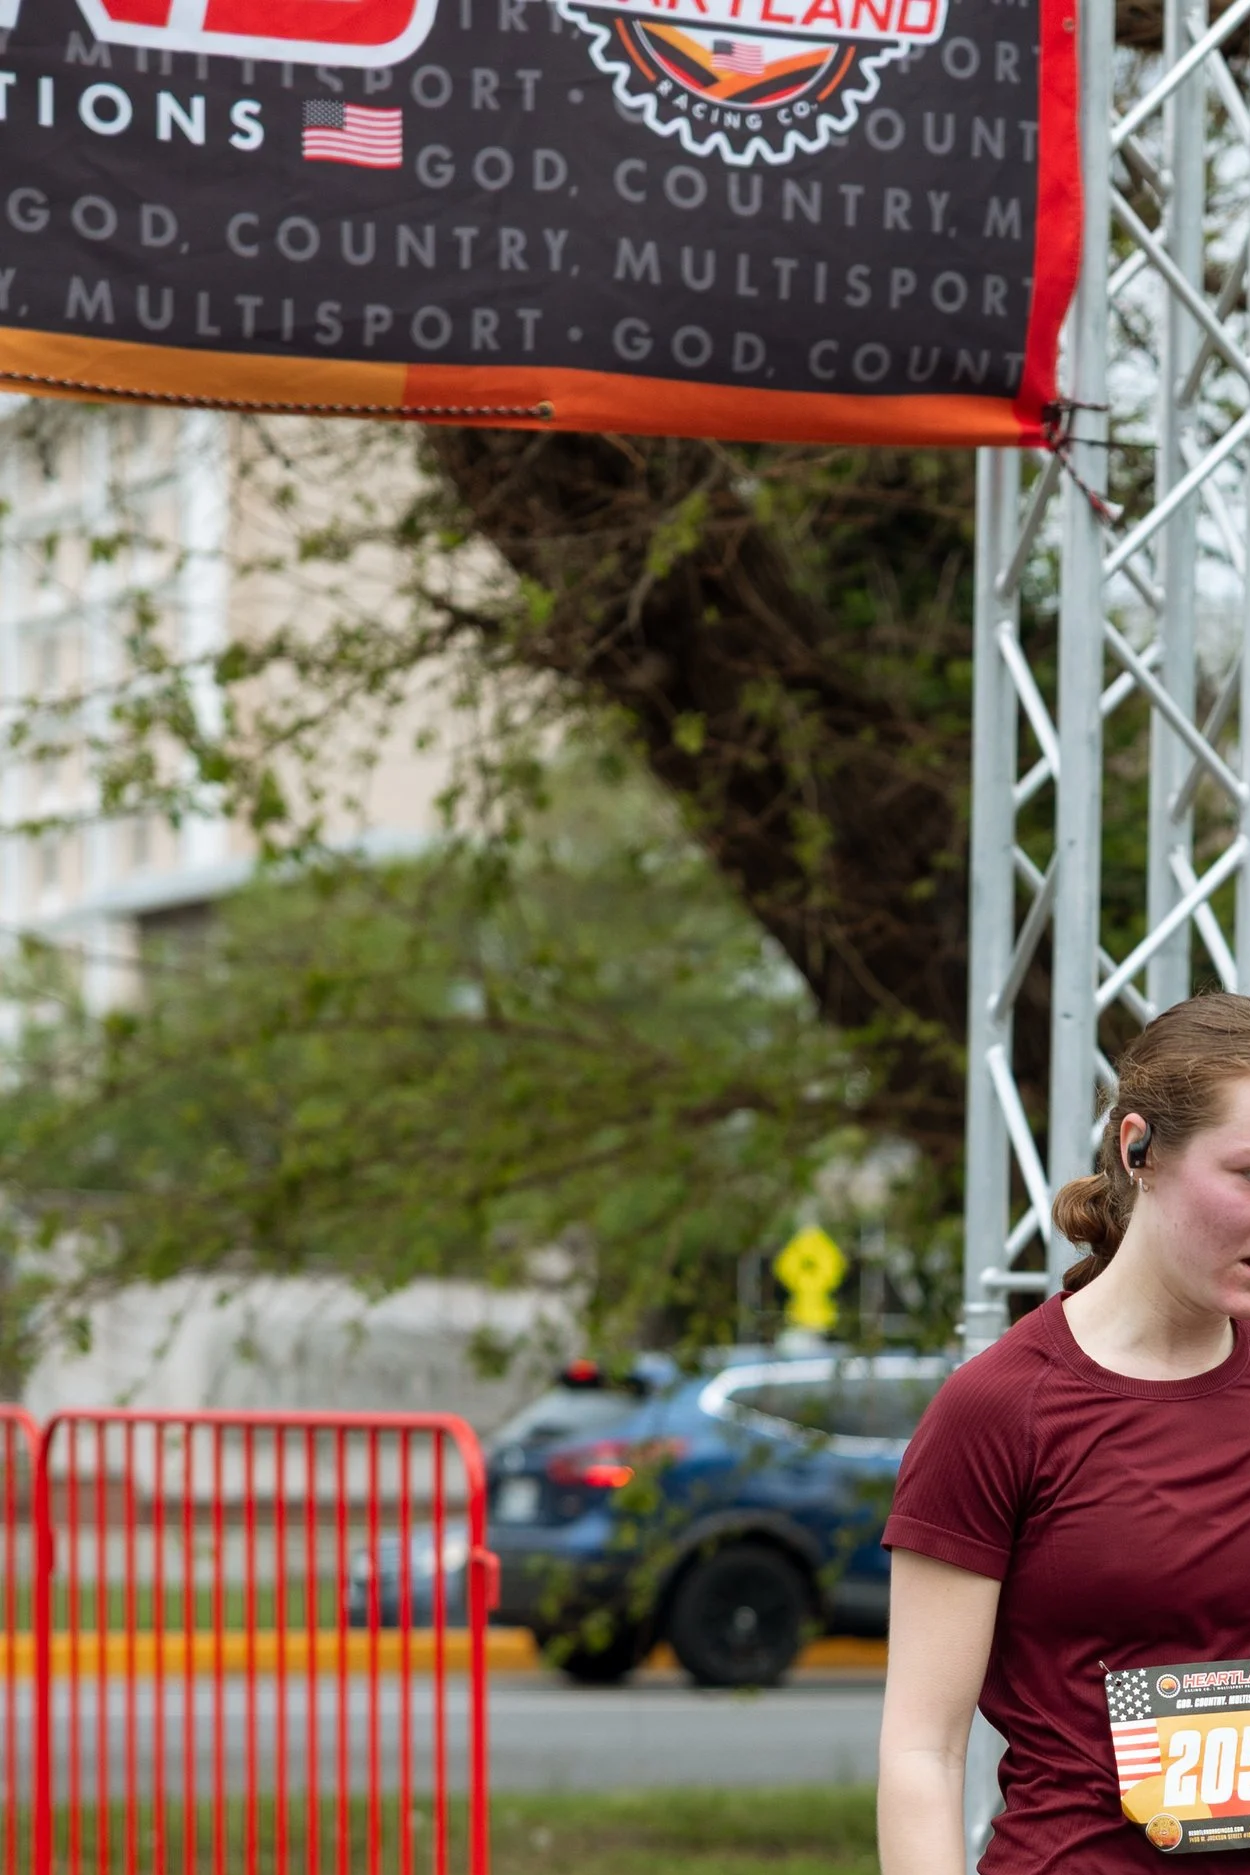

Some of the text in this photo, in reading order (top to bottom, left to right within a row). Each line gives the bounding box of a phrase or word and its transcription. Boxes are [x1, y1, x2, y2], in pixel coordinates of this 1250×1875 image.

[656, 79, 763, 131] RACING
[6, 187, 189, 255] GOD,
[226, 211, 580, 277] COUNTRY,
[416, 144, 578, 196] GOD,
[613, 158, 957, 238] COUNTRY,
[65, 275, 543, 351] MULTISPORT
[612, 317, 774, 378] GOD,
